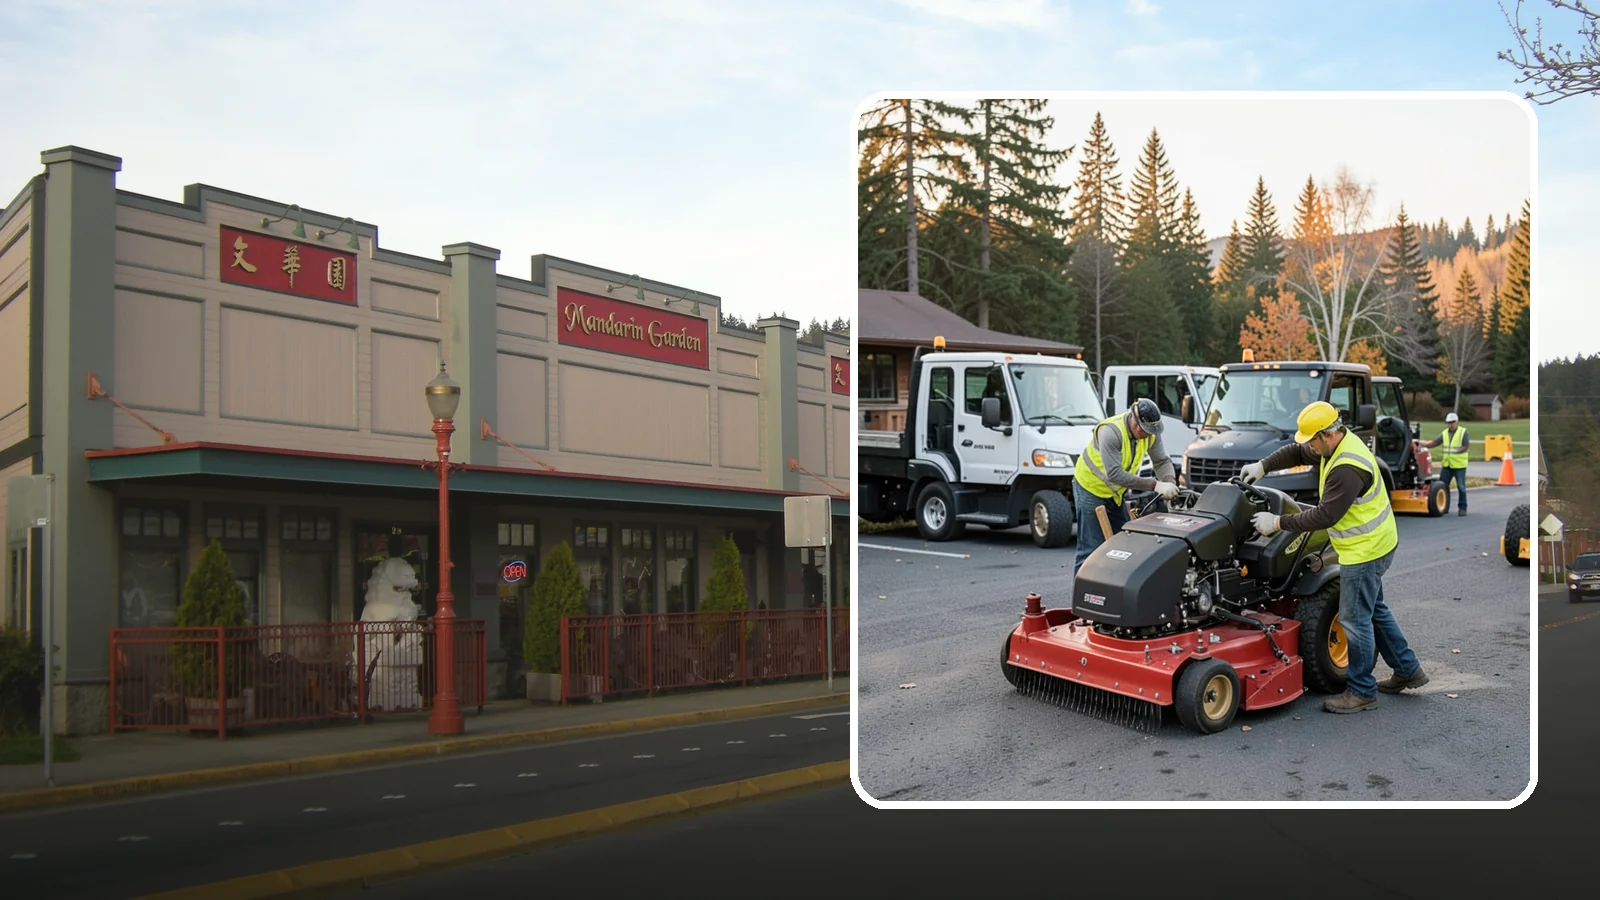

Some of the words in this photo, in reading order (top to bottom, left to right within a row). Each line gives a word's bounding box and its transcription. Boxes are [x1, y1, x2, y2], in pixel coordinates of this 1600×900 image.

[231, 236, 346, 291] 文華園
[564, 302, 643, 341] Mandarin
[648, 320, 701, 352] Garden
[503, 565, 527, 578] OPEN
